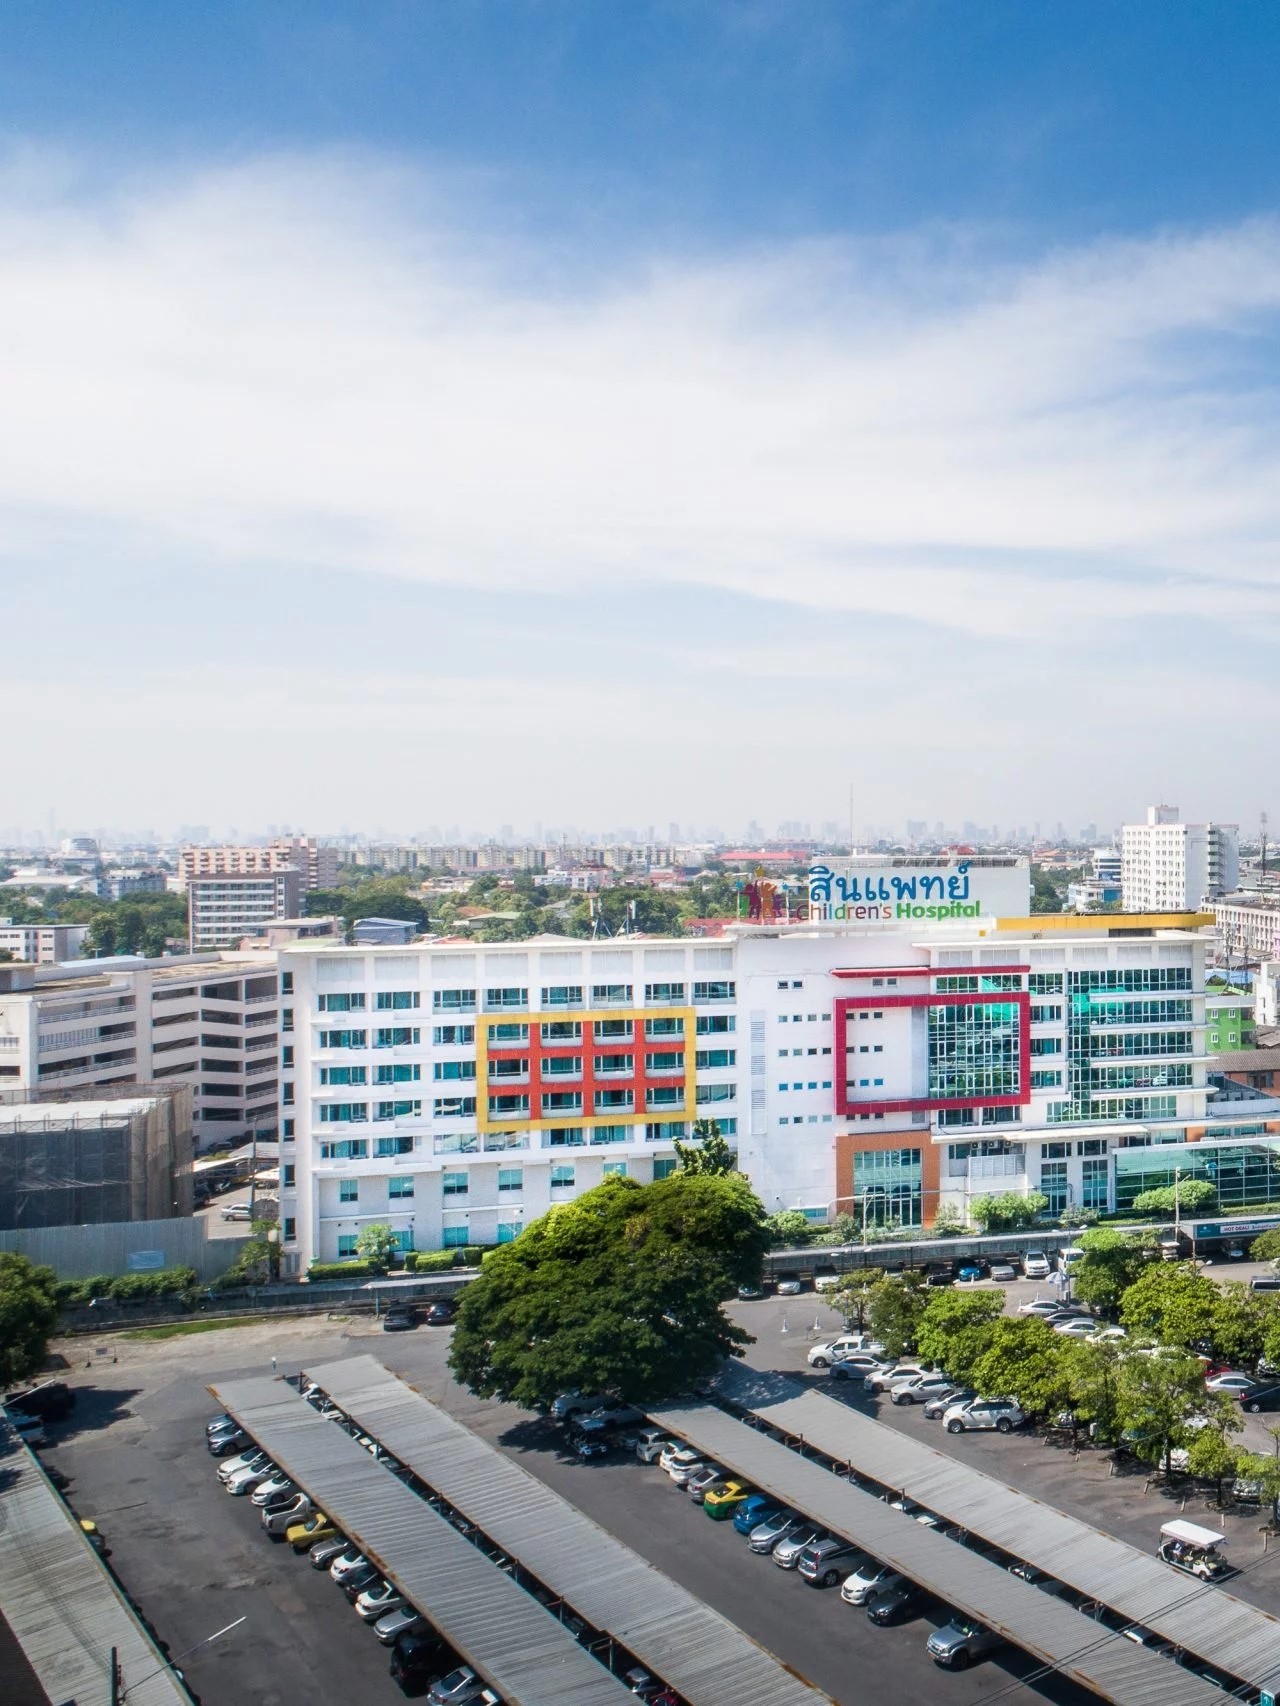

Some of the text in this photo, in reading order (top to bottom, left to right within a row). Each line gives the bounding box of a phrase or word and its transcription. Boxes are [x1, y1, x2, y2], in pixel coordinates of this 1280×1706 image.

[808, 862, 972, 901] สินแพทย์
[797, 900, 981, 922] Children's Hospital
